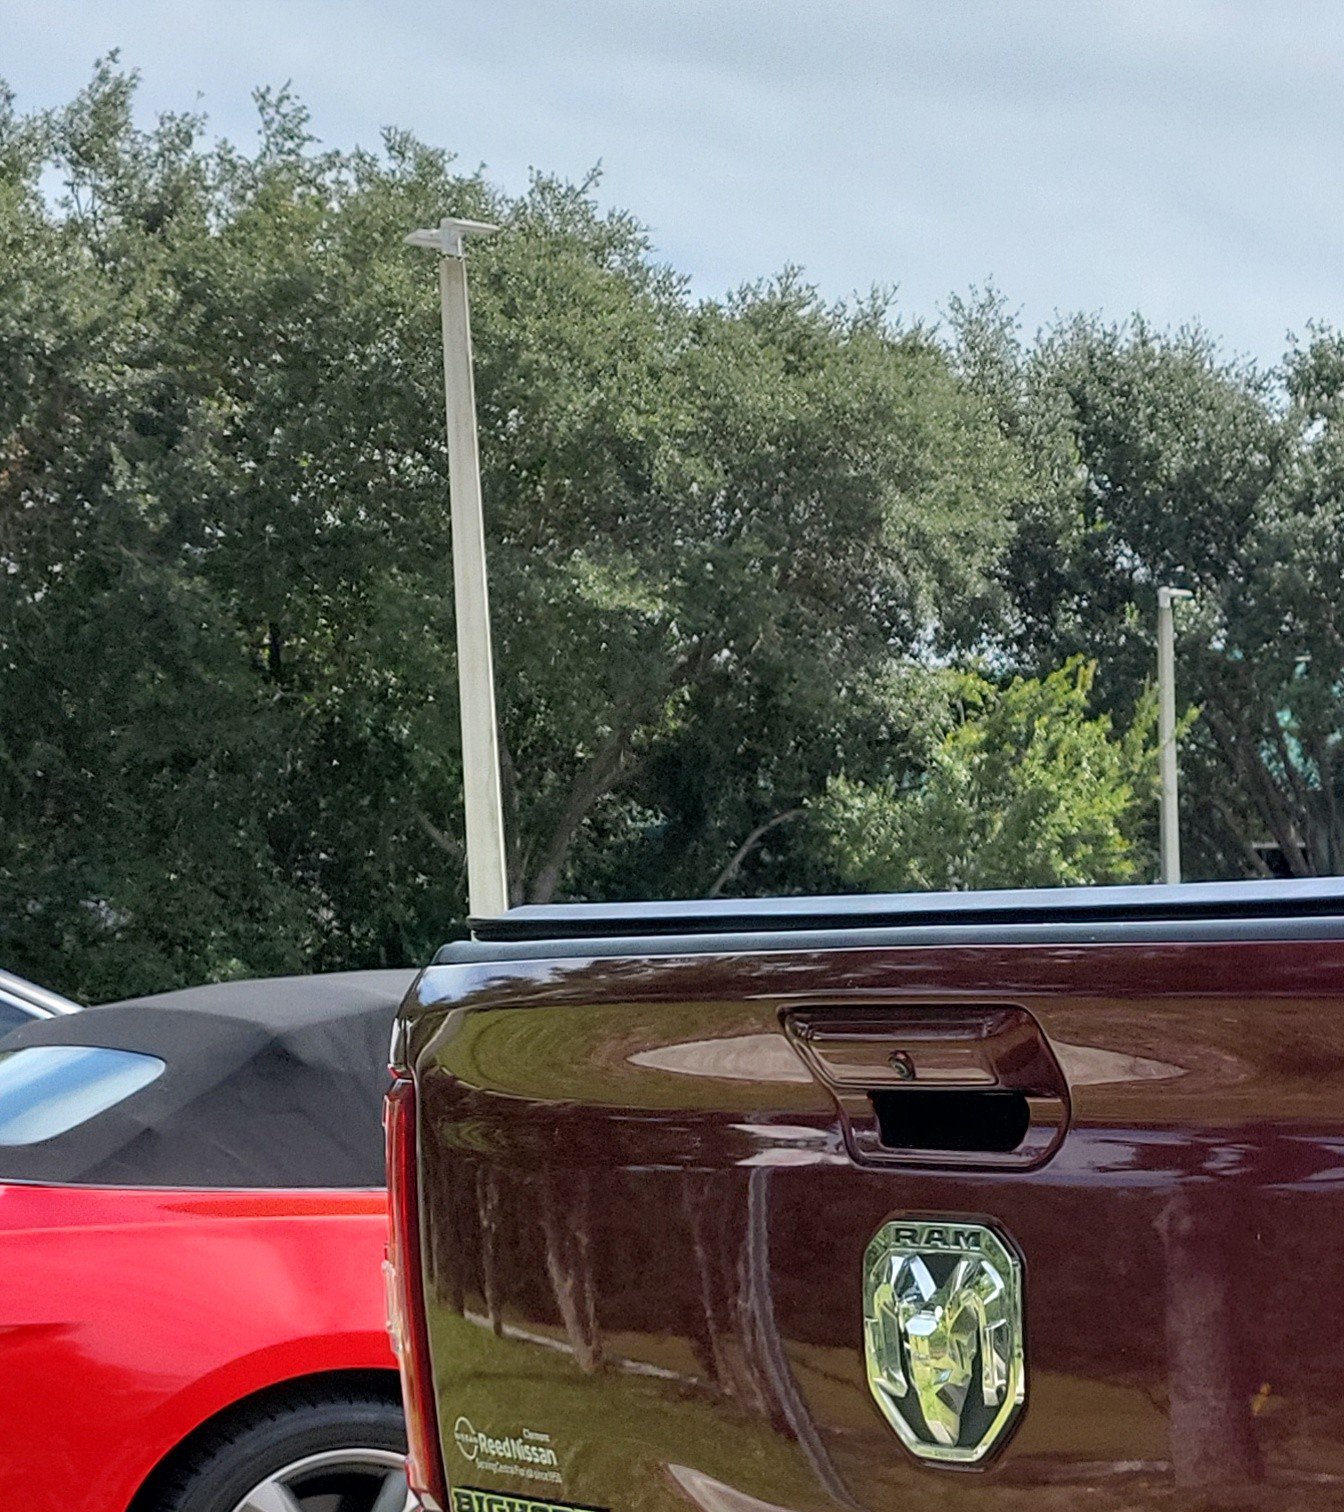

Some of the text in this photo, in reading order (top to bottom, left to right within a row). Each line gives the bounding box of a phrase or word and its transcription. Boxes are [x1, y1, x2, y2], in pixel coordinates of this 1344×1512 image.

[894, 1227, 982, 1249] RAM
[478, 1432, 511, 1458] Reed
[510, 1438, 558, 1466] Nissan
